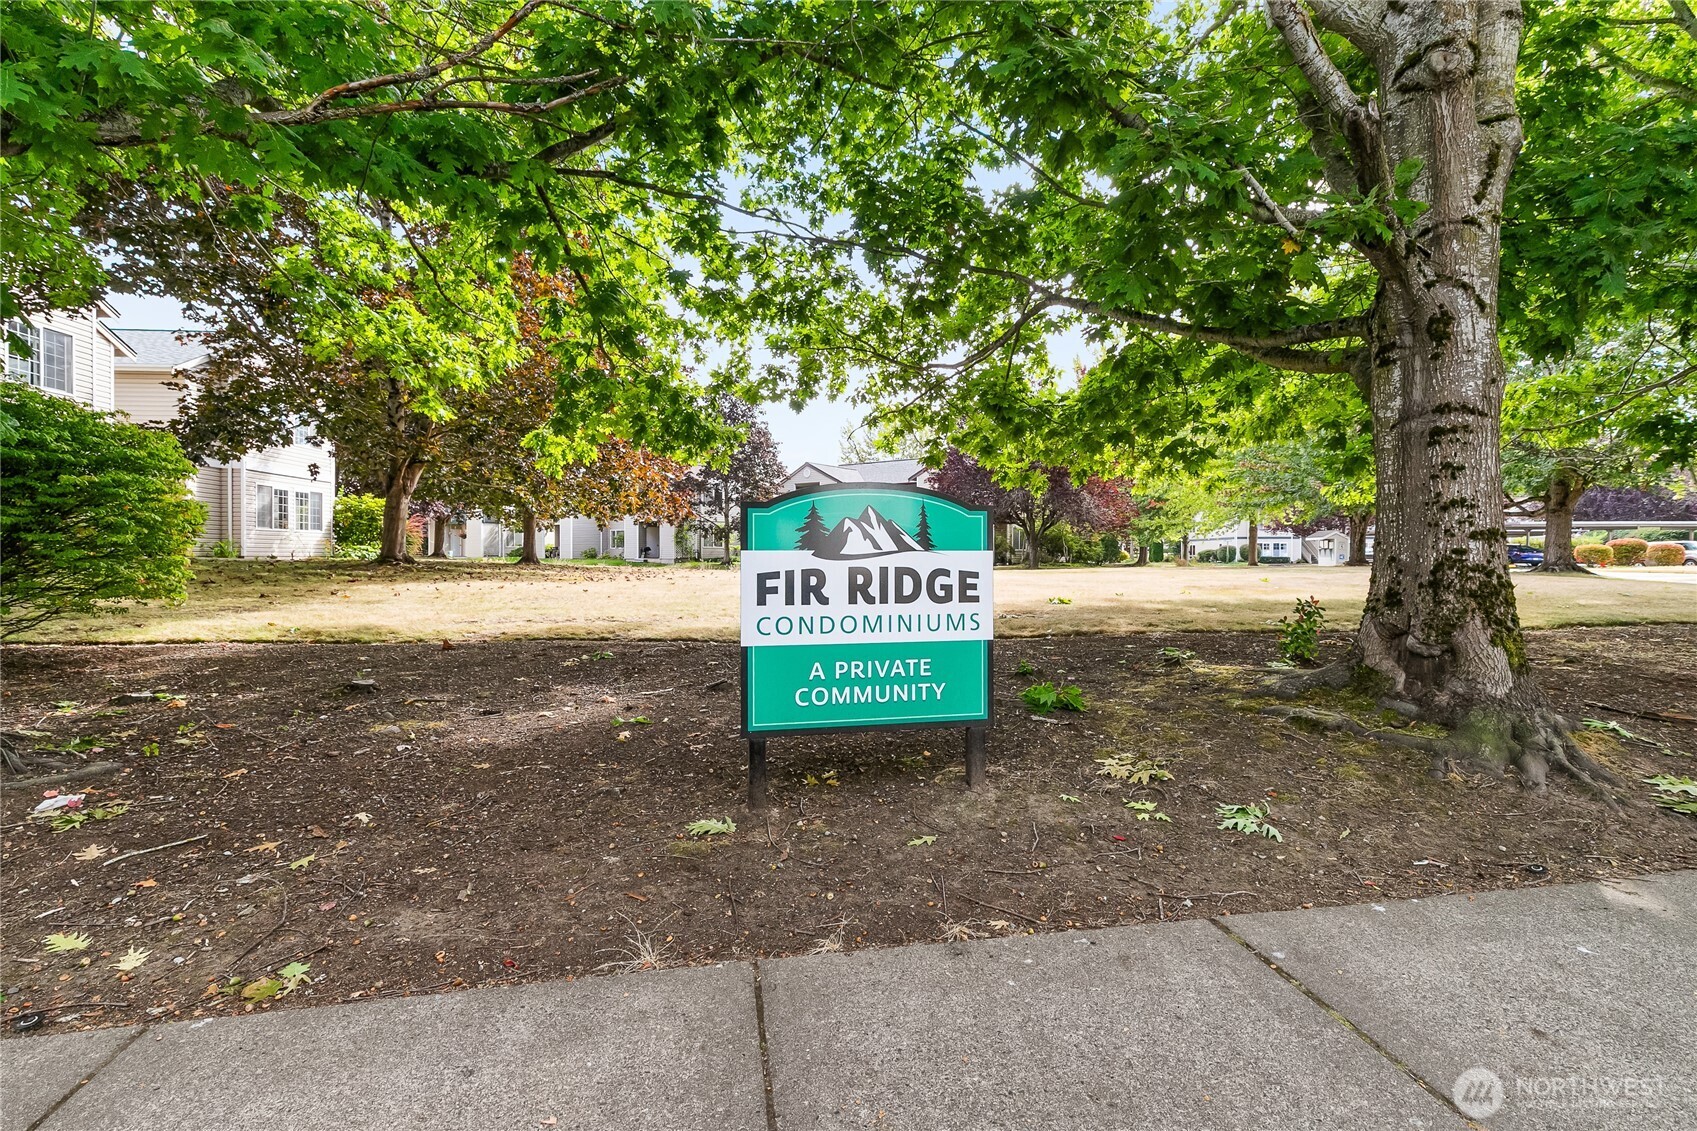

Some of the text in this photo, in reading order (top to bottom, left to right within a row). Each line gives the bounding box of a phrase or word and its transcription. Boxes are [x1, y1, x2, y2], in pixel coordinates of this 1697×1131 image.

[756, 566, 980, 606] FIR RIDGE
[756, 613, 980, 636] CONDOMINIUMS
[809, 658, 932, 680] A PRIVATE
[794, 682, 946, 706] COMMUNITY
